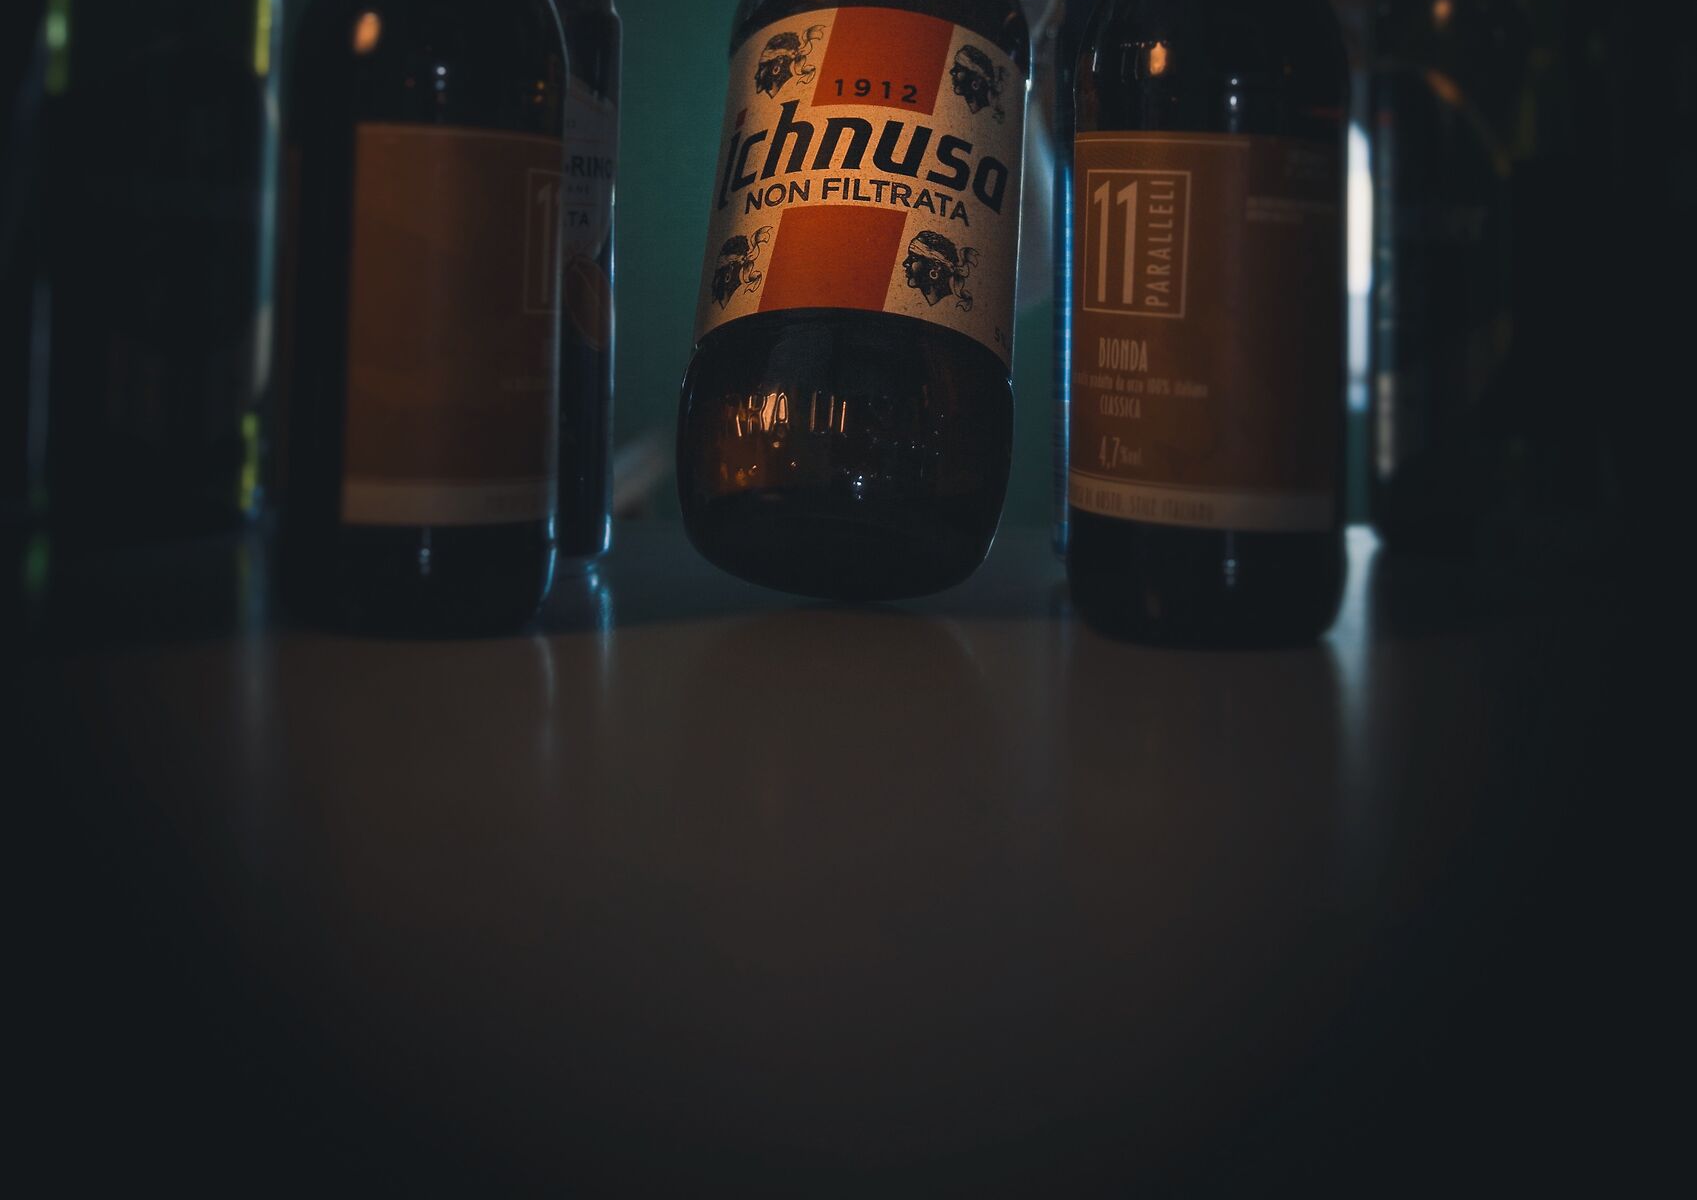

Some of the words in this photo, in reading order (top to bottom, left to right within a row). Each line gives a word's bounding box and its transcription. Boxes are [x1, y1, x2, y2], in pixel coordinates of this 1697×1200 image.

[834, 78, 918, 104] 1912
[717, 99, 1010, 215] ichnusa
[744, 179, 811, 215] NON
[821, 177, 970, 228] FILTRATA
[1093, 179, 1139, 304] 11
[1144, 179, 1175, 308] PARALLELI
[1098, 336, 1148, 373] BIONDA
[1100, 393, 1141, 419] CLASSICA
